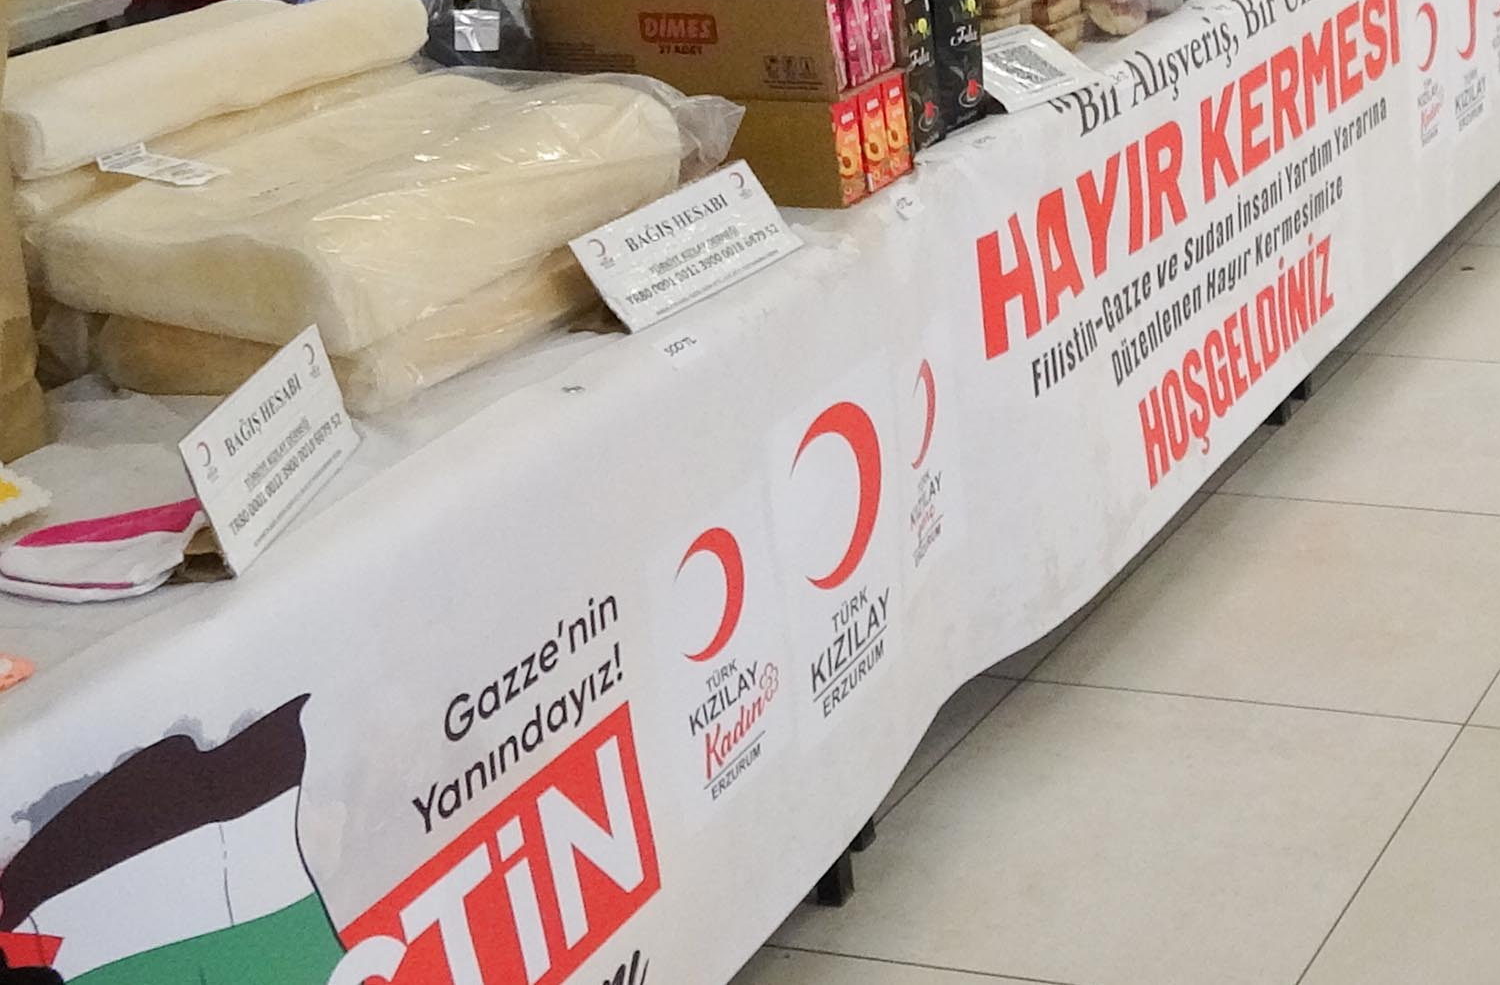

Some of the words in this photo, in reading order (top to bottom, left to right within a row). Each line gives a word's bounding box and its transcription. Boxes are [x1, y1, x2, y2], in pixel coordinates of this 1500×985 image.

[624, 220, 674, 253] BAĞIŞ
[673, 194, 729, 232] HESABI
[976, 120, 1188, 360] HAYIR
[1030, 272, 1152, 398] Filistin-Gazze
[1157, 253, 1180, 289] ve
[1183, 222, 1235, 280] Sudan
[1236, 171, 1284, 233] İnsani
[1285, 140, 1333, 196] Yardım
[1333, 95, 1388, 156] Yararına
[1111, 284, 1202, 387] Düzenlenen
[1206, 248, 1252, 303] Hayır
[1254, 174, 1344, 266] Kermesimize
[1137, 232, 1336, 491] HOŞGELDİNİZ
[224, 414, 262, 457] BAĞIŞ
[261, 373, 303, 424] HESABI
[810, 587, 890, 694] KIZILAY
[831, 585, 868, 632] TÜRK
[443, 594, 618, 741] Gazze'nin
[688, 661, 759, 737] KIZILAY
[705, 659, 738, 693] TÜRK
[822, 639, 885, 719] ERZURUM
[411, 641, 623, 834] Yanındayız!
[704, 696, 766, 780] Kadın
[710, 742, 761, 801] ERZURUM
